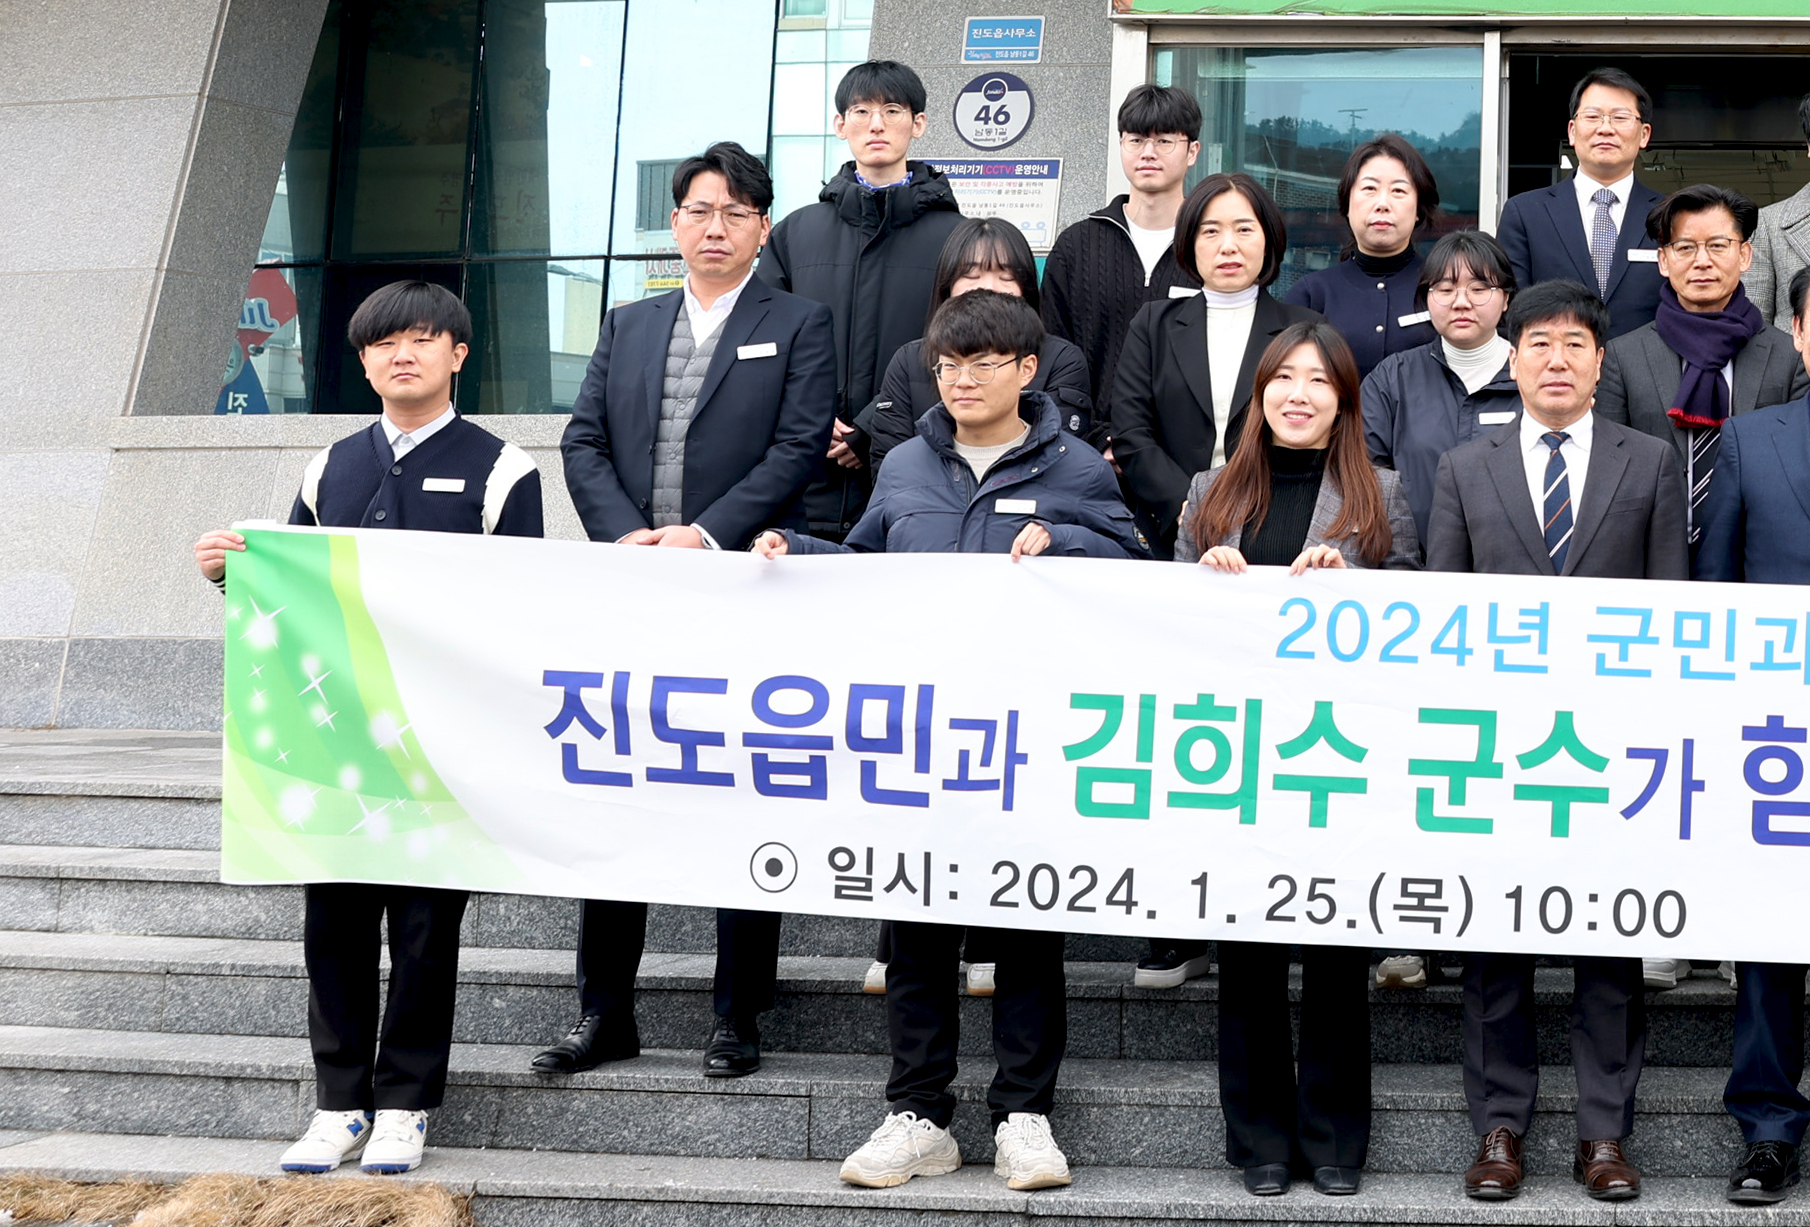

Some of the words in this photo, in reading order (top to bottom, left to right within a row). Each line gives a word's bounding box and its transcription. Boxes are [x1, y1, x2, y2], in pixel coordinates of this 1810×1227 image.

[971, 28, 1037, 39] 진도읍사무소
[974, 104, 1011, 126] 46
[931, 164, 1049, 175] 정보처리기기(CCTV)운영안내
[1275, 597, 1551, 674] 2024년
[541, 668, 1029, 812] 진도읍민과
[1061, 692, 1370, 829] 김희수
[1407, 706, 1706, 840] 군수가
[826, 844, 960, 903] 일시:
[990, 859, 1158, 921] 2024.
[1191, 871, 1238, 924] 1.
[1264, 872, 1476, 938] 25.(목)
[1504, 884, 1688, 938] 10:00
